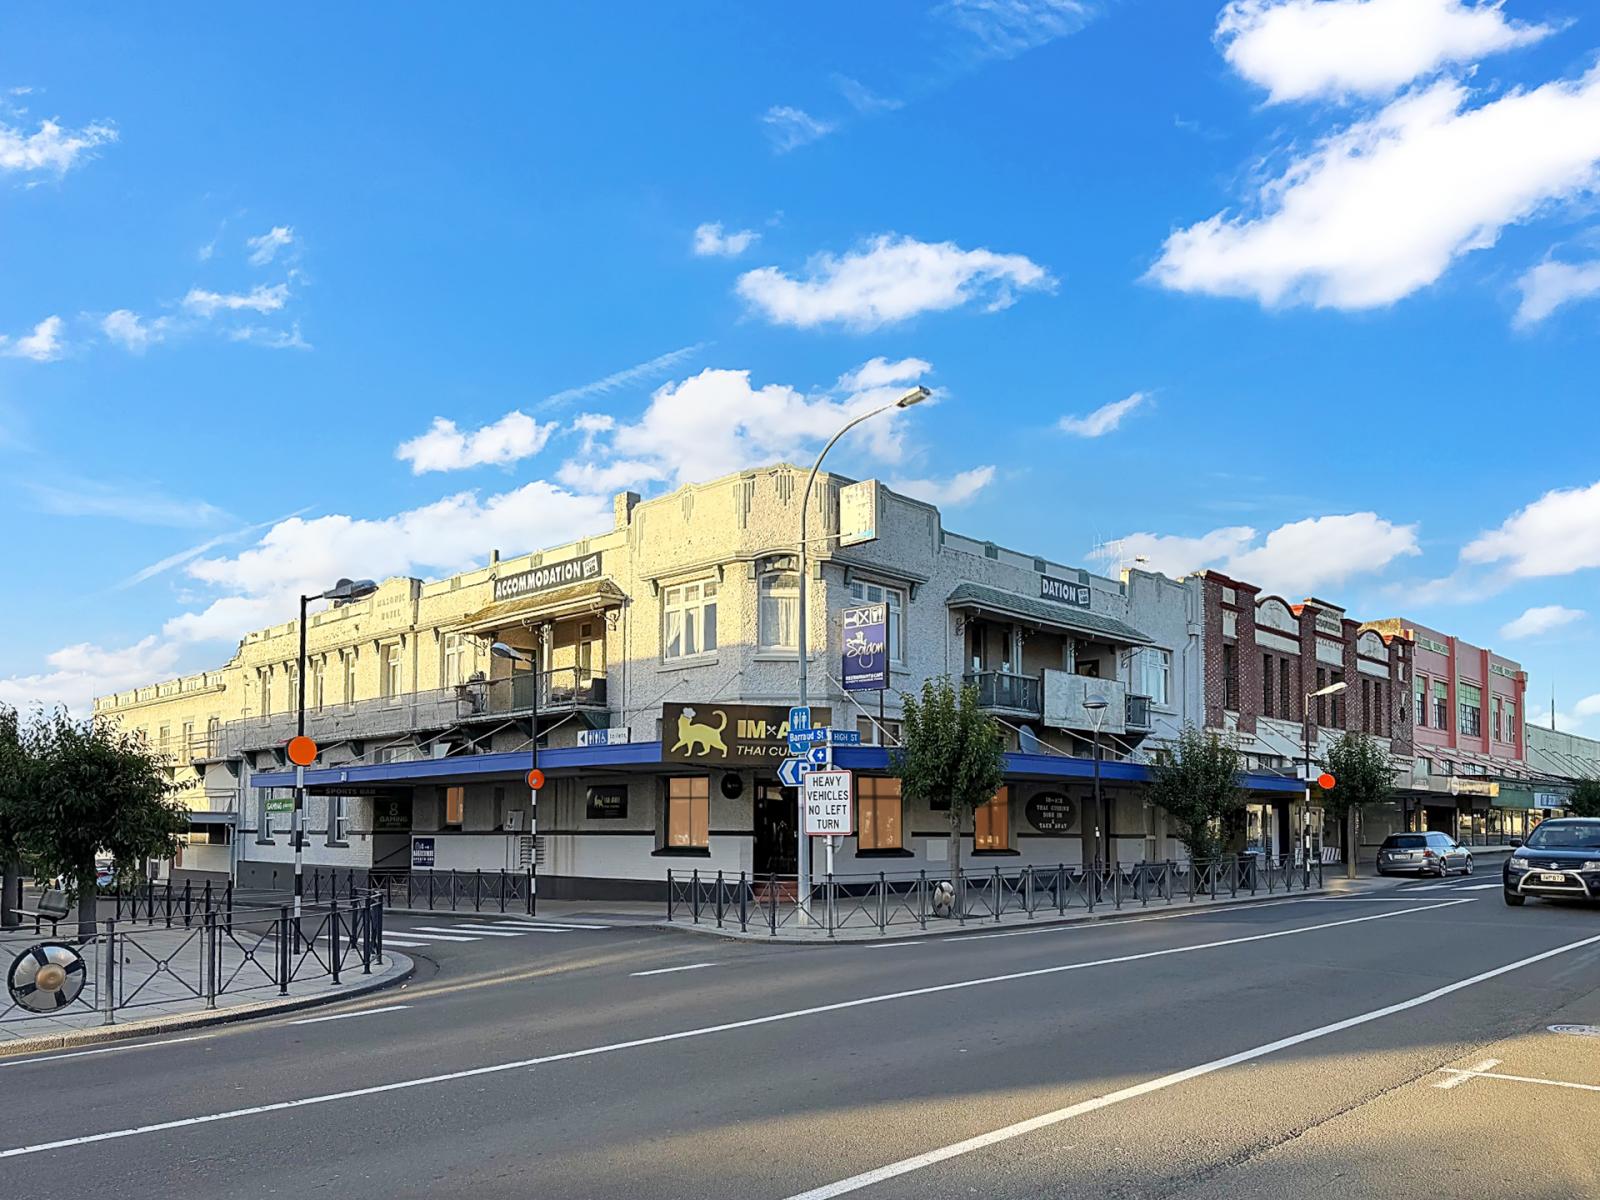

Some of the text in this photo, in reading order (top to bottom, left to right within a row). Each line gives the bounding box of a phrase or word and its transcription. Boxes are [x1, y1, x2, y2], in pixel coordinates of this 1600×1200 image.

[495, 561, 581, 598] ACCOMMODATION
[1042, 579, 1076, 602] DATION
[789, 732, 814, 742] Barraud
[816, 730, 824, 739] St
[851, 734, 858, 742] ST
[736, 746, 766, 756] THAI
[812, 776, 842, 787] HEAVY
[807, 790, 849, 801] VEHICLES
[808, 804, 847, 815] NO LEFT
[817, 819, 840, 830] TURN
